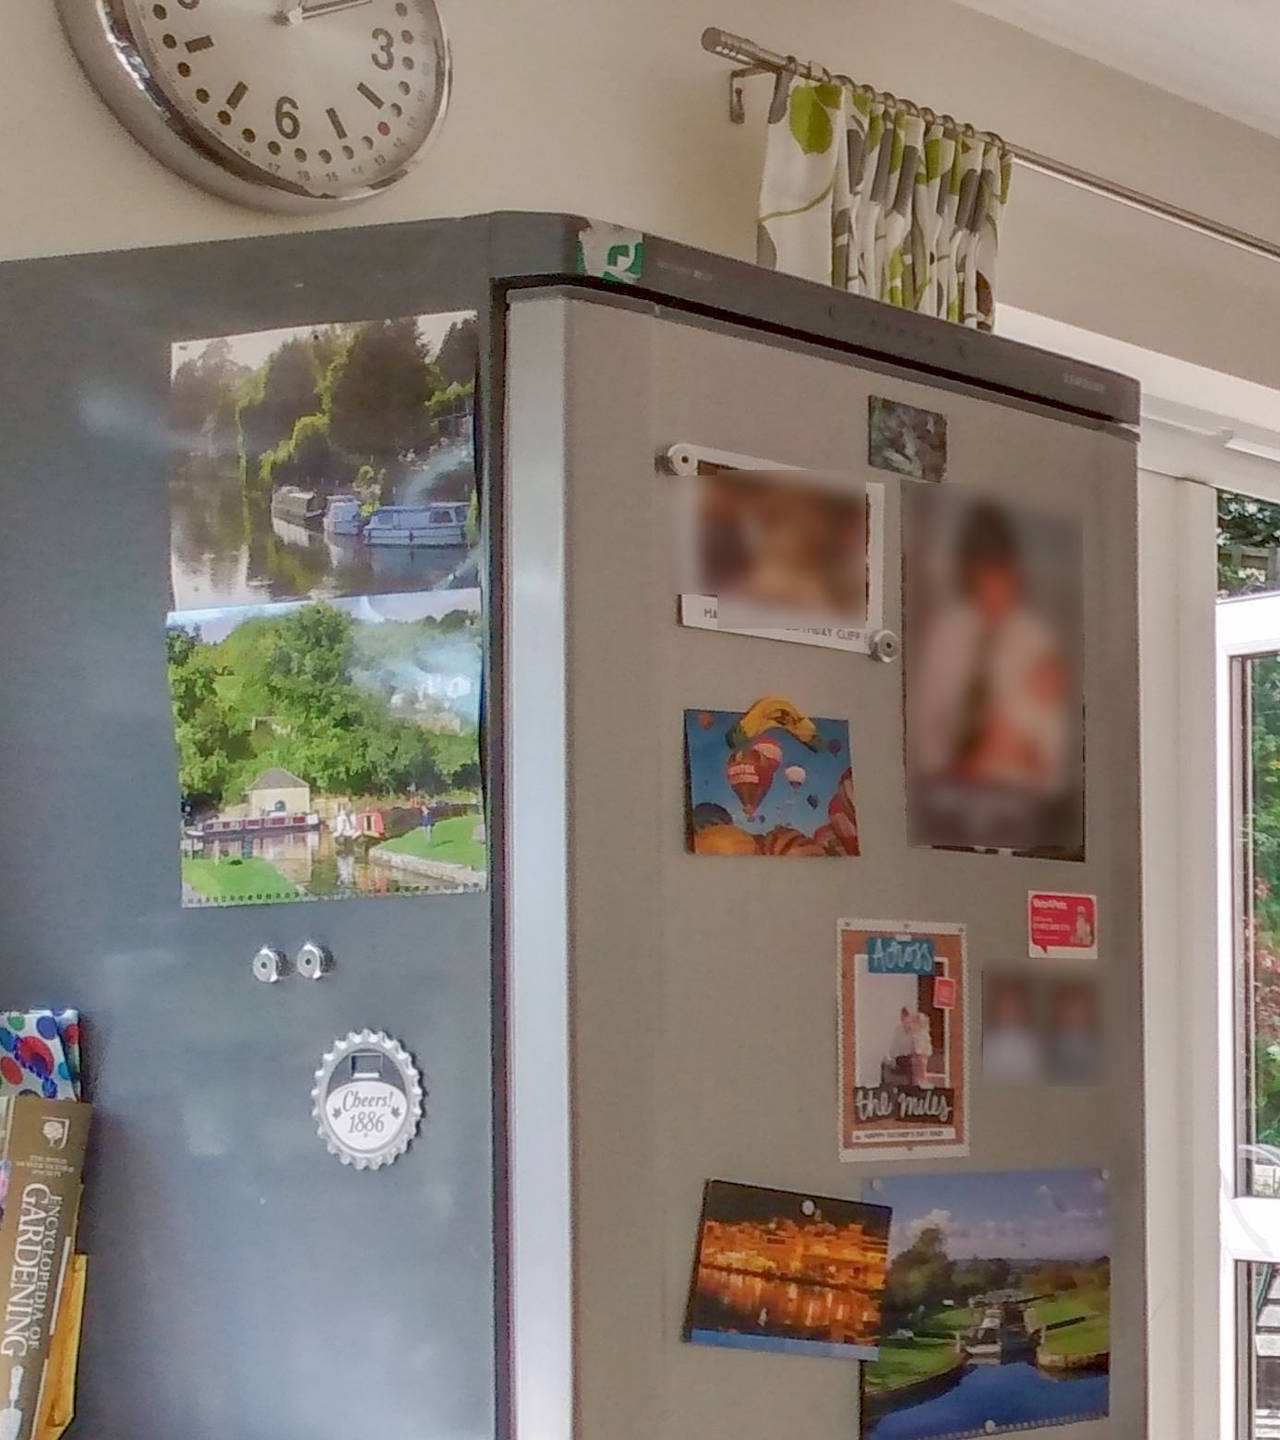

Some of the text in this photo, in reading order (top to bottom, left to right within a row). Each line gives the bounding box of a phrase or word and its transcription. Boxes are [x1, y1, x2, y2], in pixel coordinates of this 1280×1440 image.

[371, 27, 394, 71] 3
[274, 96, 301, 140] 6
[872, 938, 934, 972] Across
[342, 1090, 394, 1112] Cheers!
[856, 1089, 892, 1121] the
[348, 1111, 385, 1133] 1886
[1, 1183, 51, 1358] GARDENING
[33, 1195, 63, 1322] ENCYCLOPEDIA
[28, 1326, 42, 1351] OF
